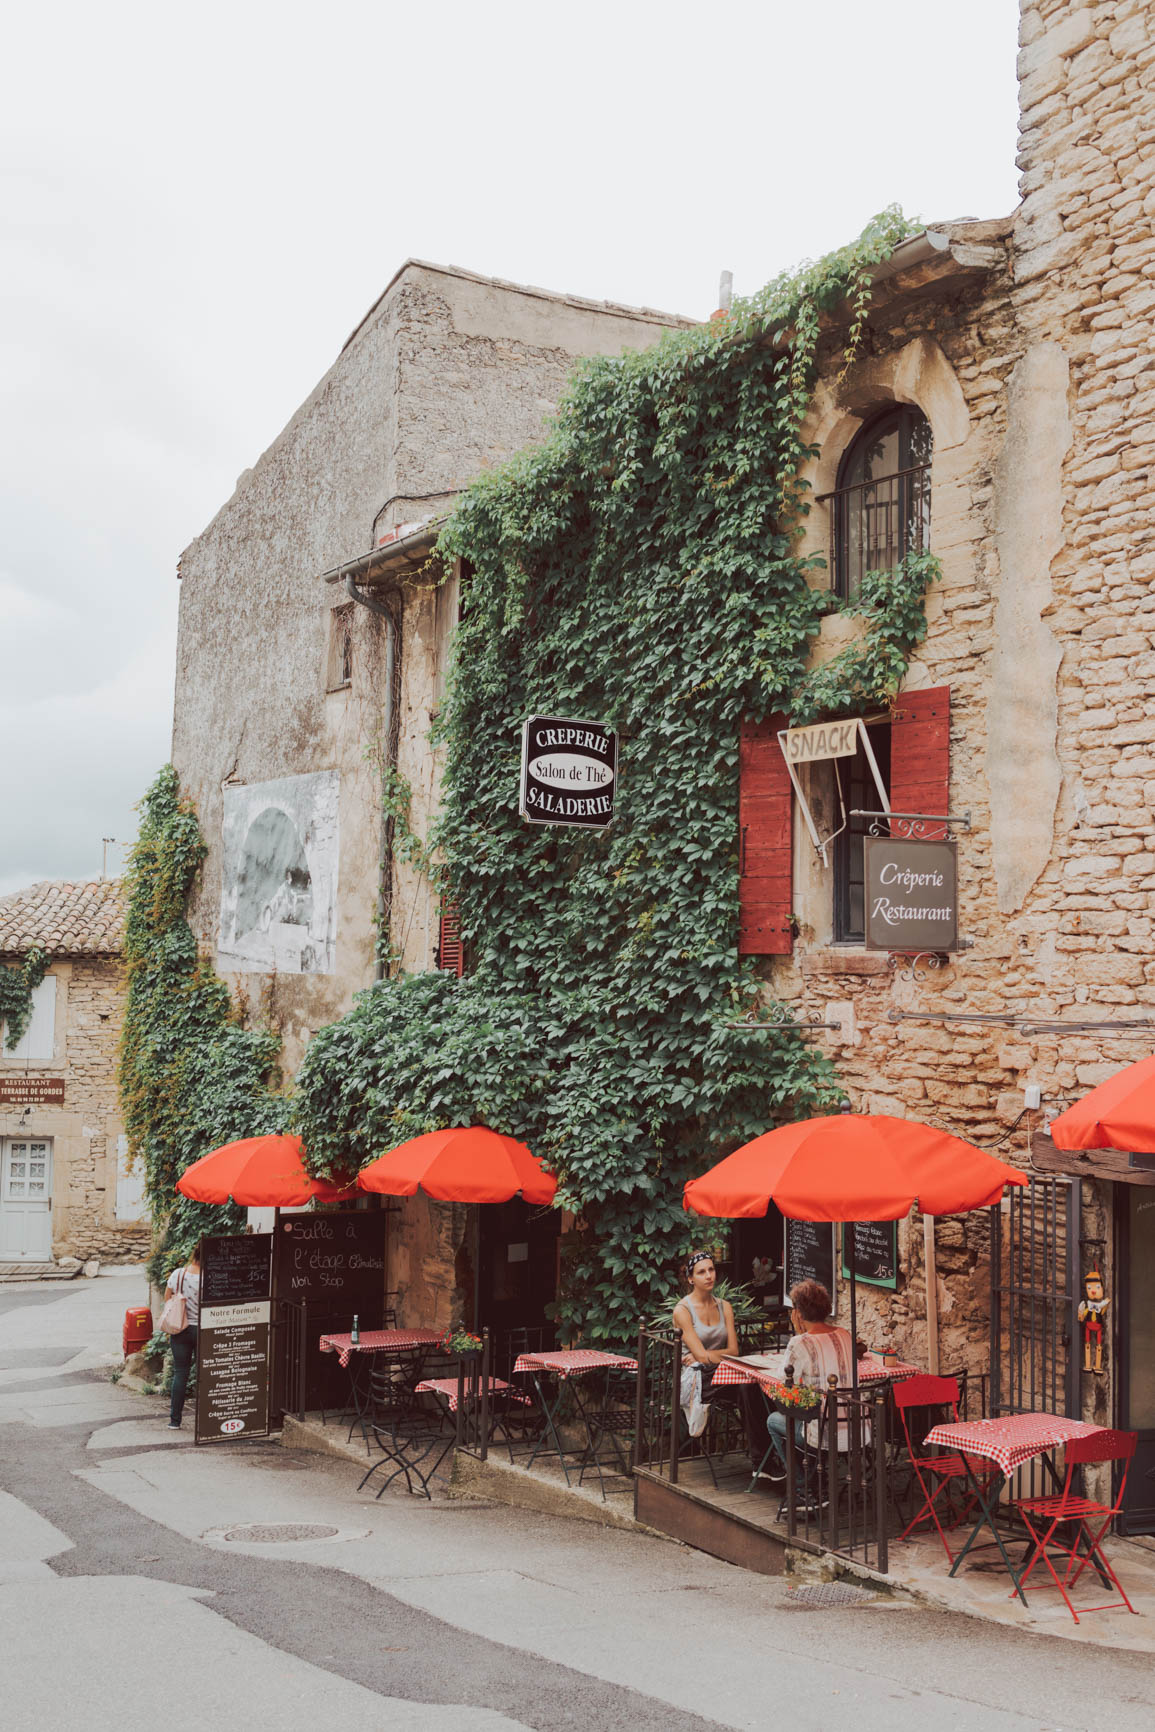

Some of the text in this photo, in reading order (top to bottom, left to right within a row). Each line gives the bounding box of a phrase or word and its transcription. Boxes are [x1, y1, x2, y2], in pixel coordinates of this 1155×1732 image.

[535, 728, 609, 754] CREPERIE
[790, 725, 853, 759] SNACK
[535, 761, 606, 783] Salon de Thé
[526, 787, 612, 816] SALADERIE
[880, 863, 944, 894] Crêperie
[872, 897, 952, 926] Restaurant
[292, 1220, 358, 1240] Salle à
[291, 1273, 344, 1289] Non Stop
[232, 1306, 260, 1315] Formule
